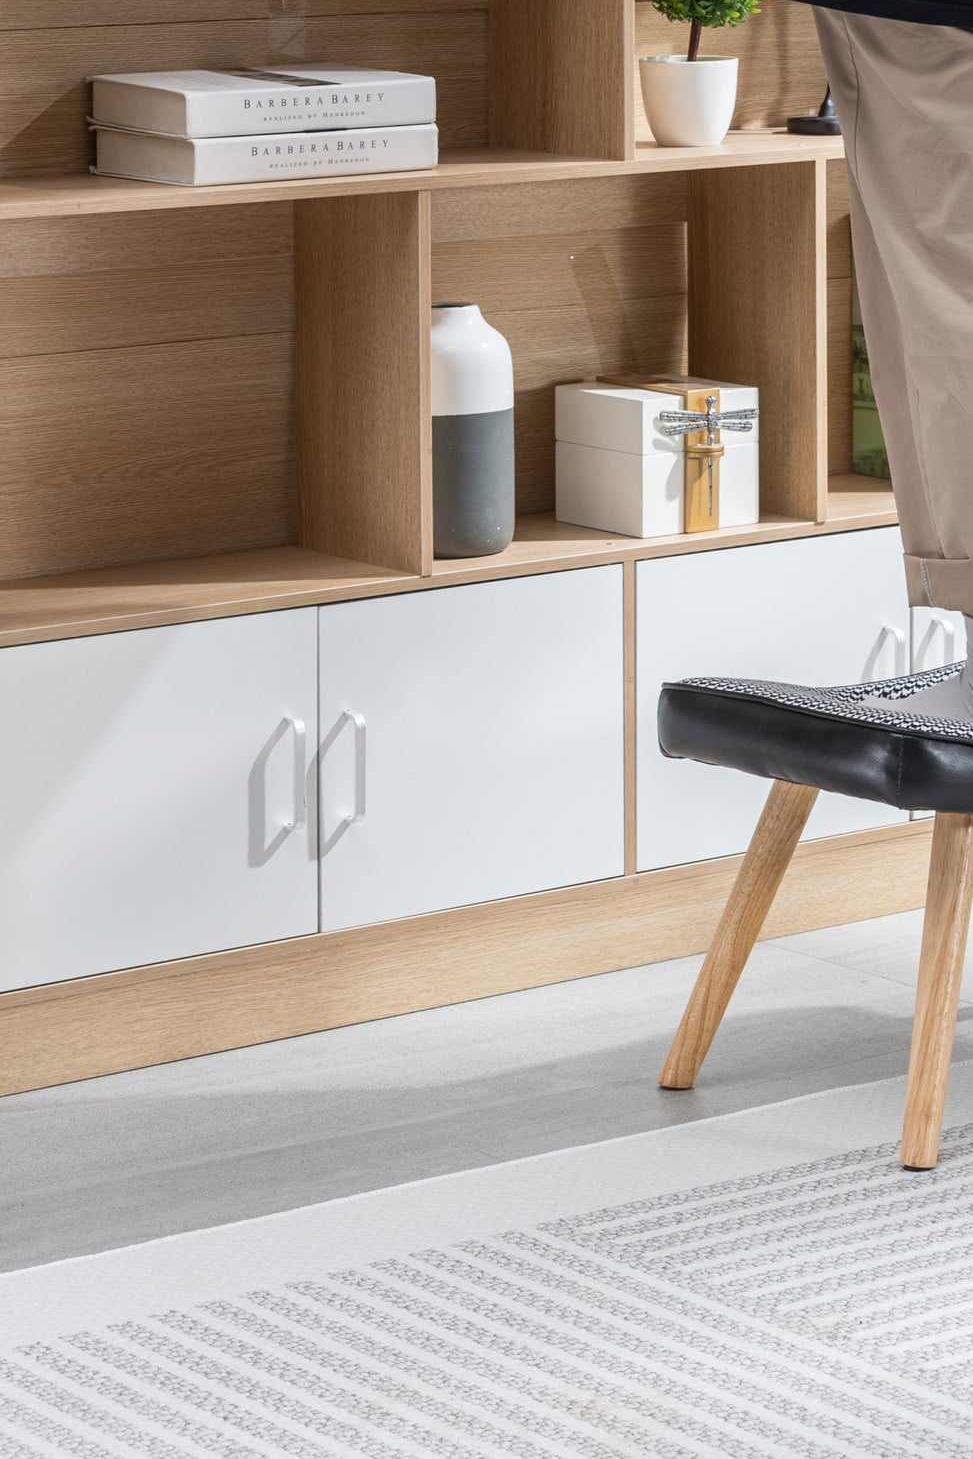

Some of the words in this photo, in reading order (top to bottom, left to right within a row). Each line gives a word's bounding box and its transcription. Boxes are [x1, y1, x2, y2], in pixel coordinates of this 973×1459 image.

[244, 97, 323, 109] BARBERA
[331, 93, 384, 104] BAREY
[251, 143, 329, 156] BARBERA
[337, 139, 389, 151] BAREY
